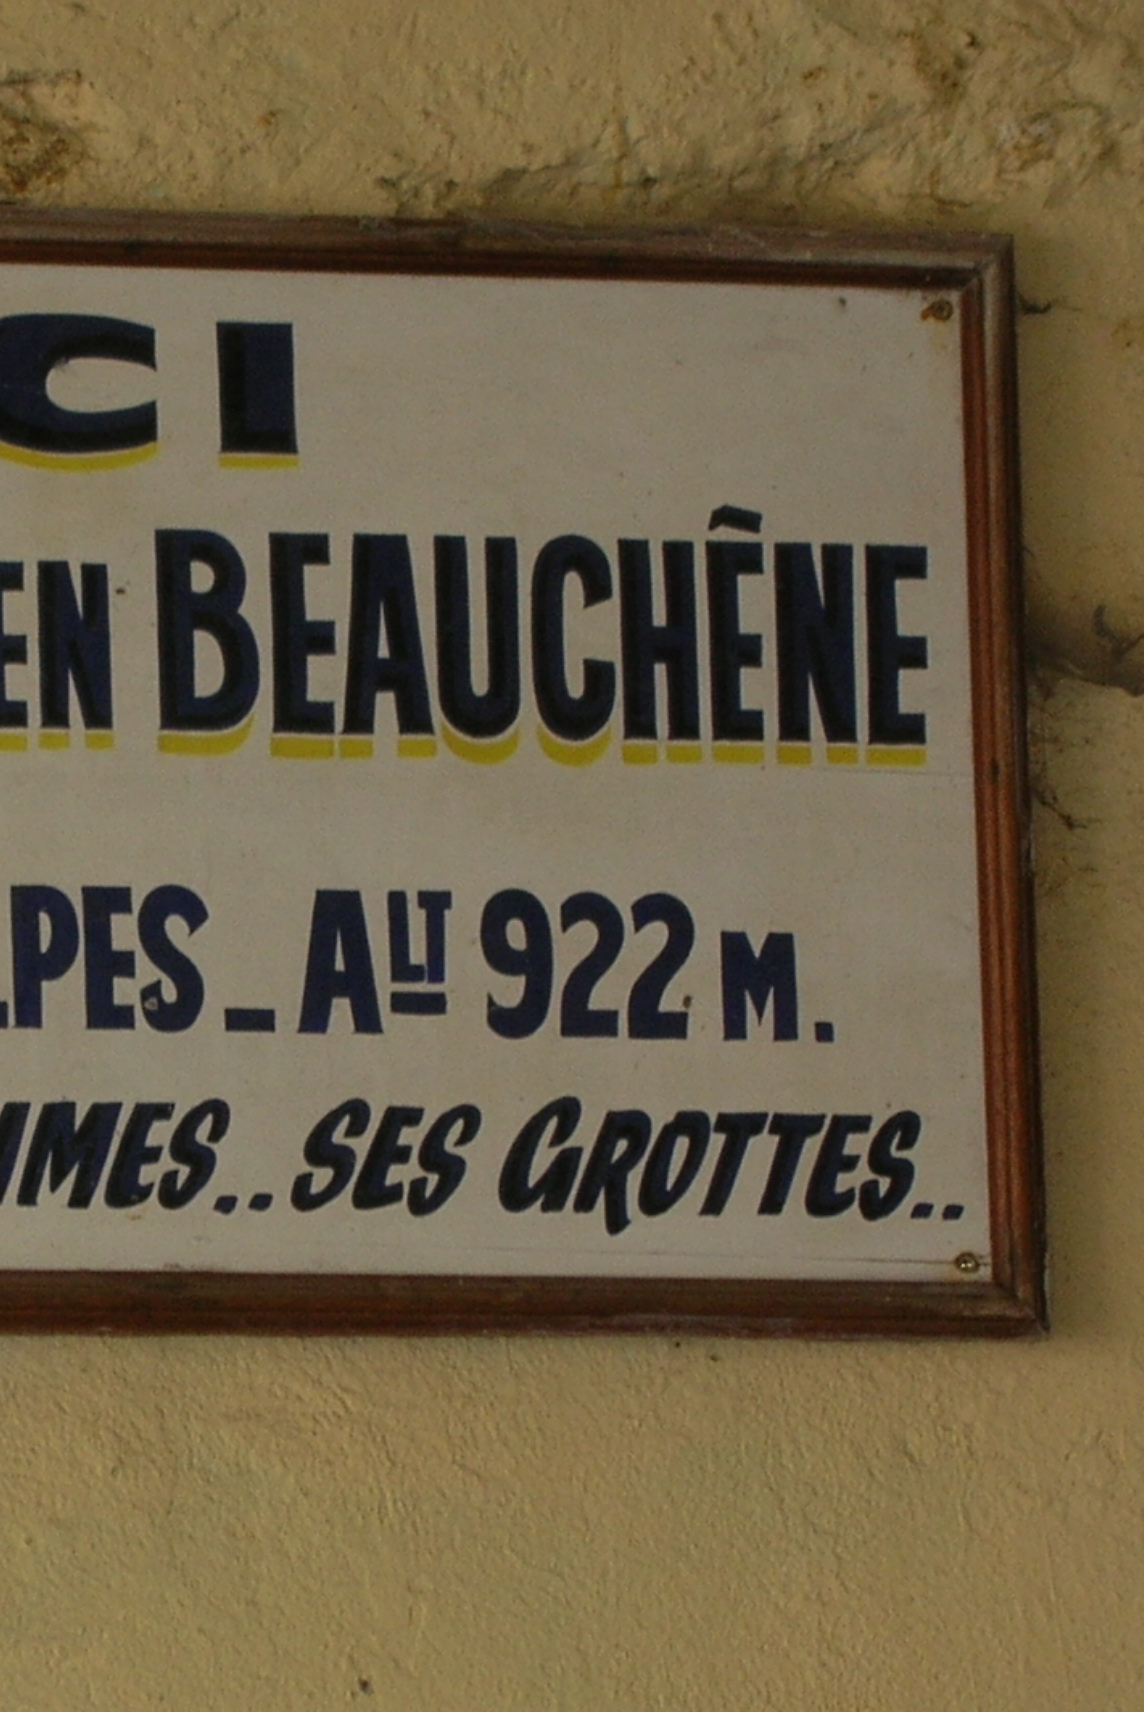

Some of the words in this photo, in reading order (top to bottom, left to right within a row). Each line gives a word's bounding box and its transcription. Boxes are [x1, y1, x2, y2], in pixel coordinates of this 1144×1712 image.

[155, 505, 928, 746] BEAUCHÊNE
[480, 889, 696, 1040] 922
[721, 931, 834, 1043] M.
[291, 1098, 481, 1217] SES
